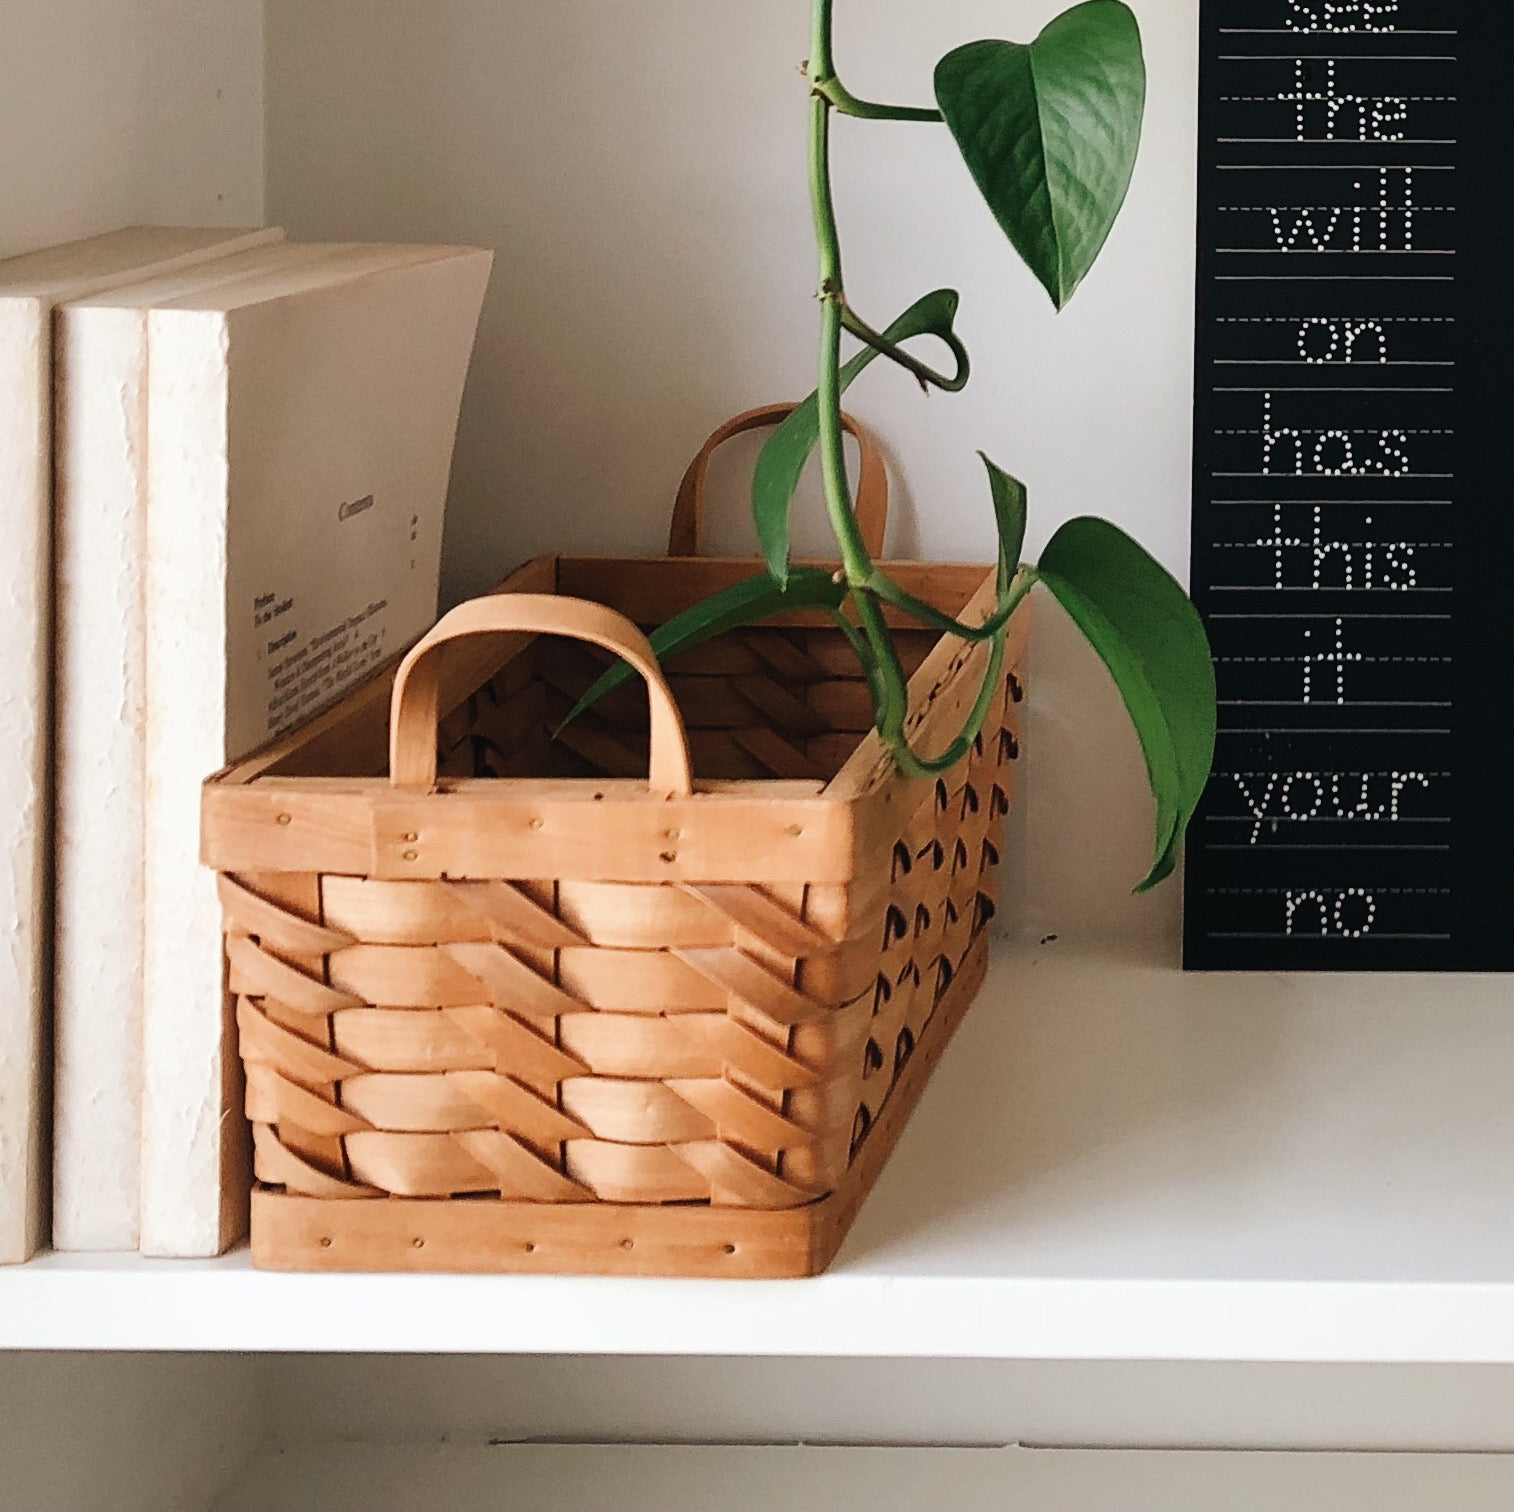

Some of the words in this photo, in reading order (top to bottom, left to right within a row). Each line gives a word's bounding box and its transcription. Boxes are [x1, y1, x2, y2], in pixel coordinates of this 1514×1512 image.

[1278, 59, 1407, 142] the
[1270, 167, 1412, 253] will
[1297, 317, 1386, 364] on
[1263, 393, 1409, 477] has
[1257, 504, 1416, 591] this
[1304, 619, 1361, 704] it
[1232, 771, 1430, 845] your
[1284, 888, 1377, 939] no
